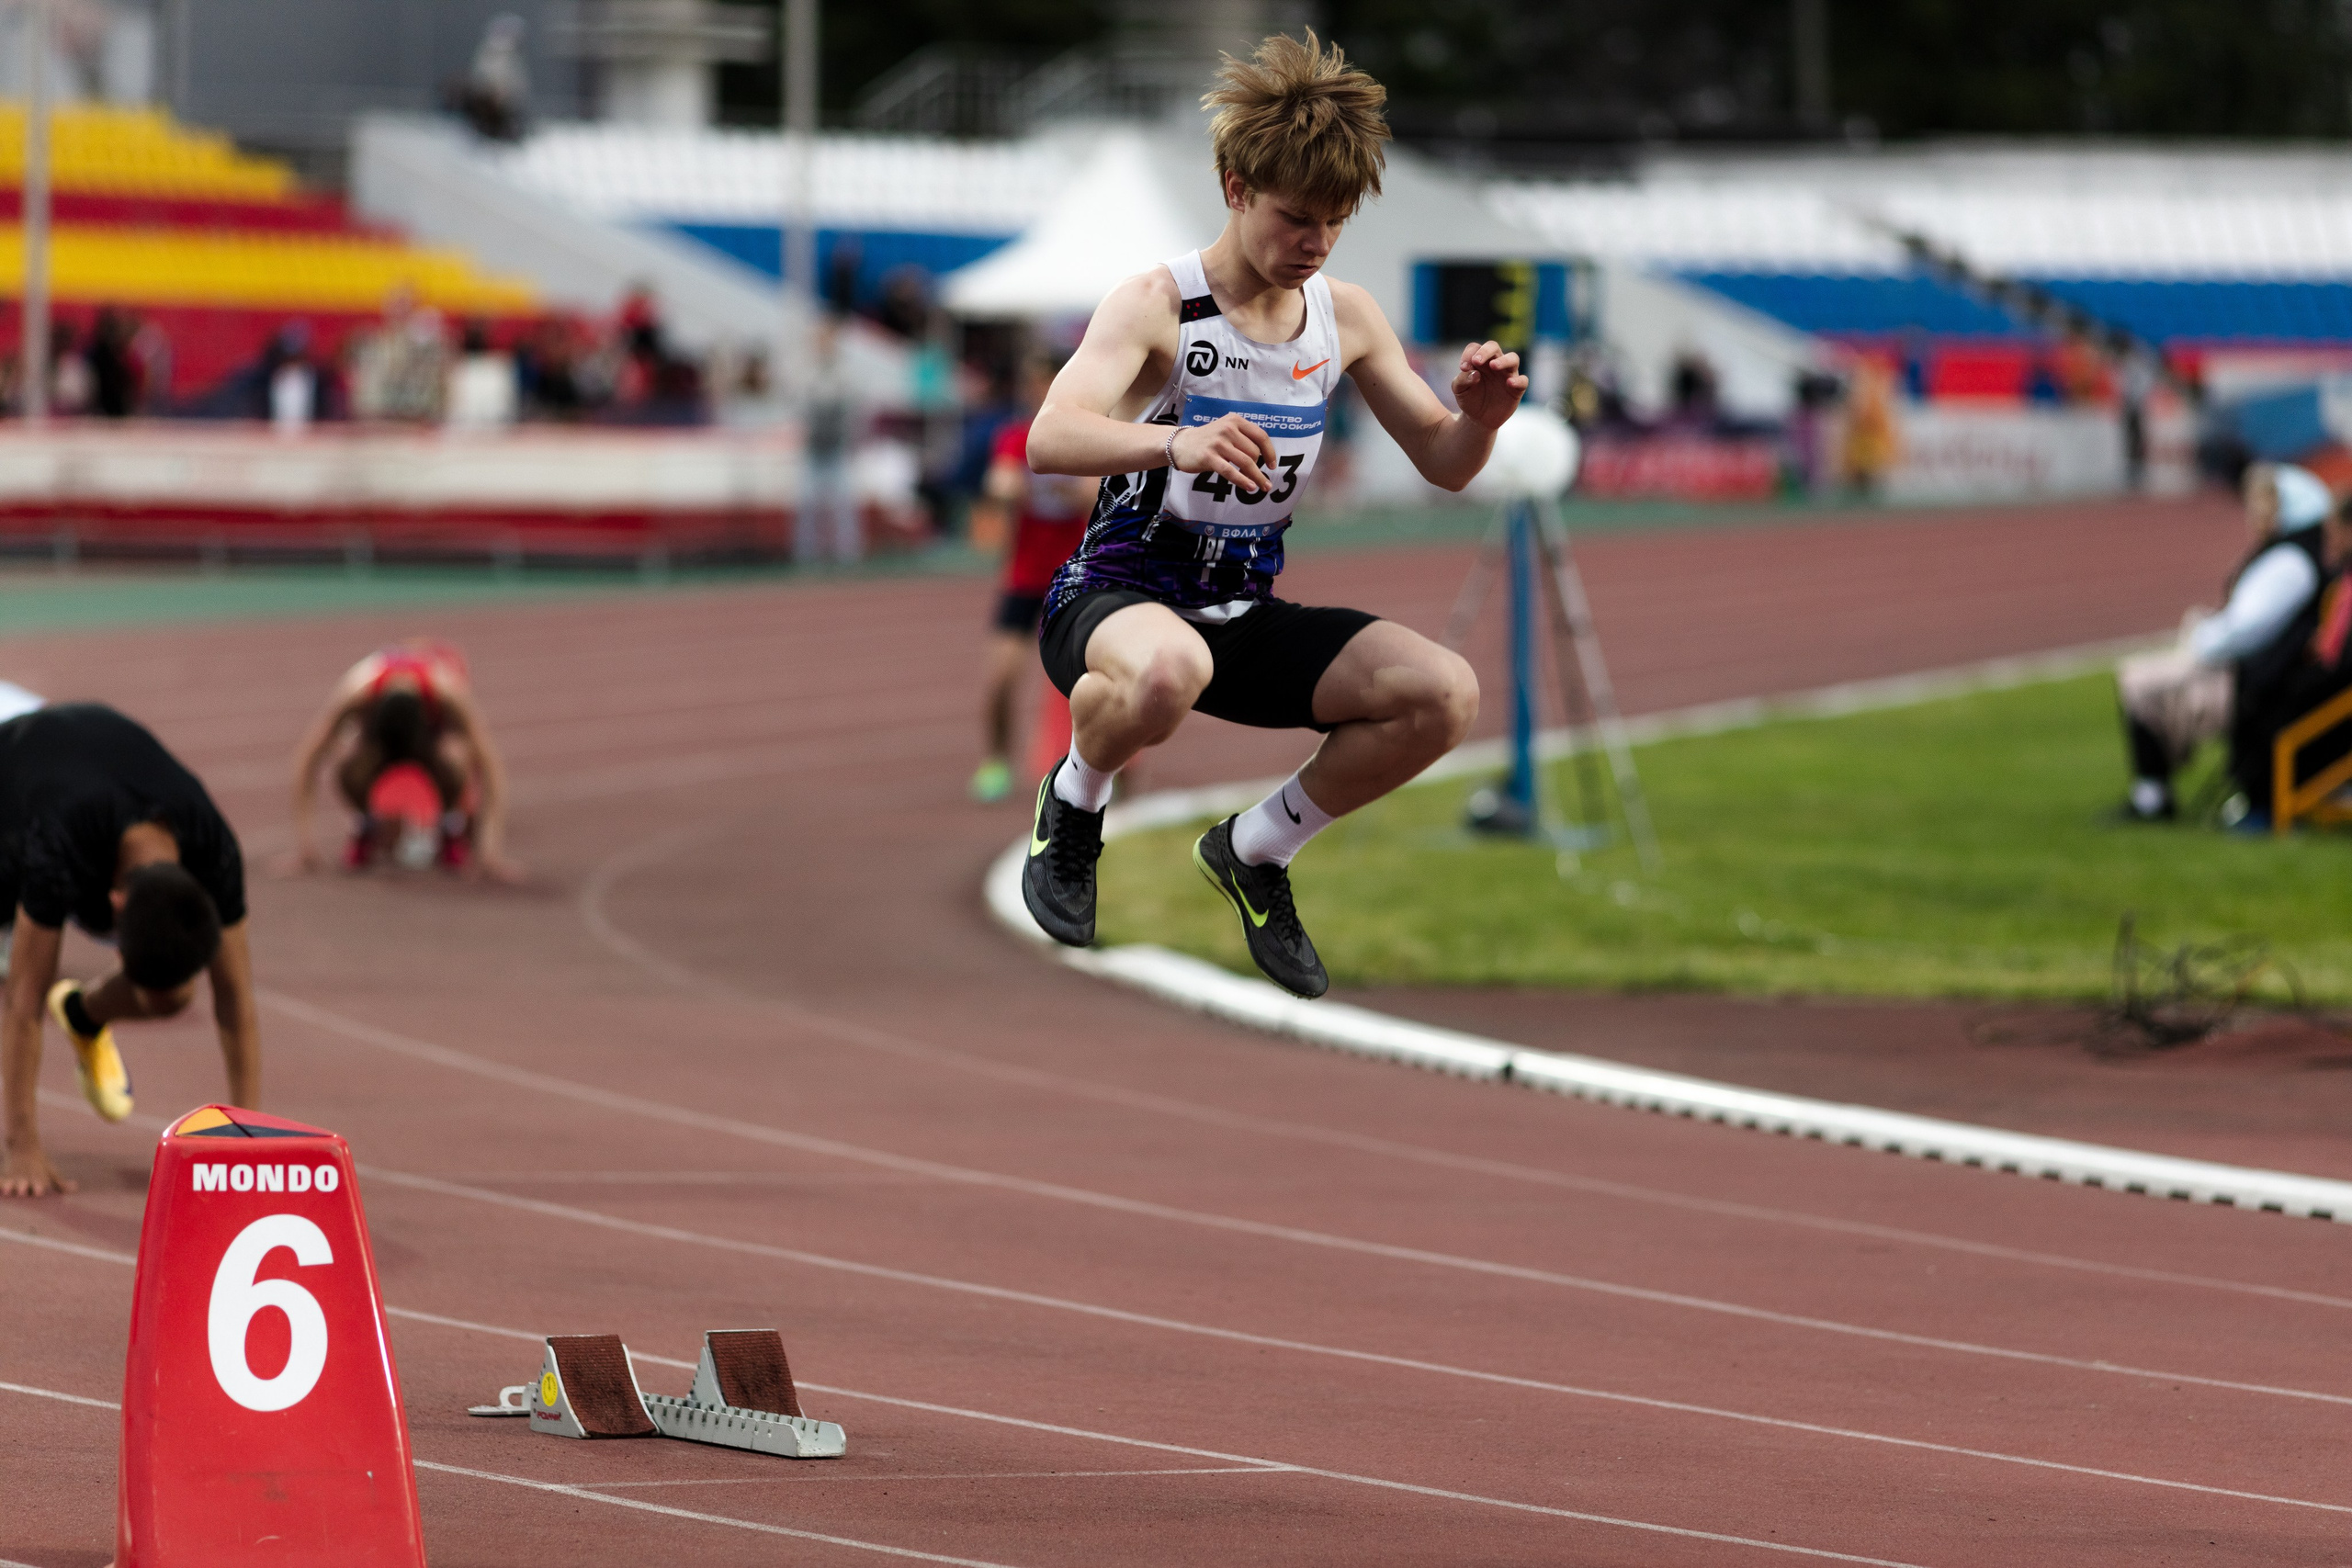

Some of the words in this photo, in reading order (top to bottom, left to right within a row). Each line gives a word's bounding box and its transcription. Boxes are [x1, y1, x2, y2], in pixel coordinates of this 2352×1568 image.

[1225, 355, 1250, 370] NN
[1229, 411, 1303, 423] ЕРВЕНСТВО
[1288, 420, 1322, 430] ОКРУГА
[1222, 528, 1258, 538] ВФЛА
[192, 1163, 339, 1192] MONDO
[208, 1213, 334, 1412] 6
